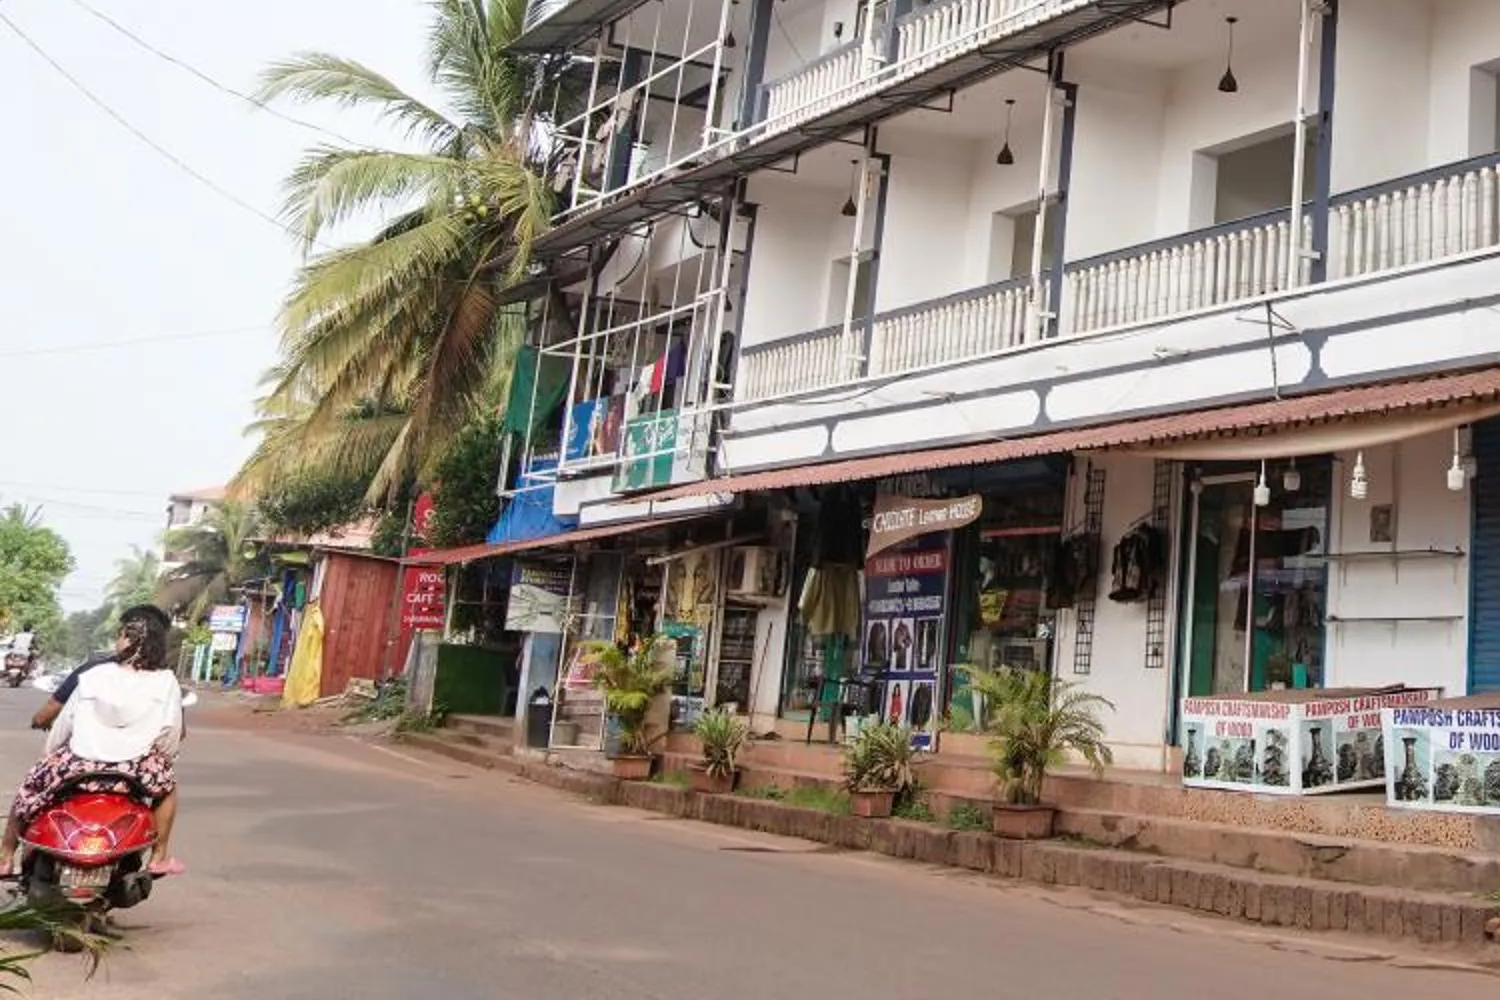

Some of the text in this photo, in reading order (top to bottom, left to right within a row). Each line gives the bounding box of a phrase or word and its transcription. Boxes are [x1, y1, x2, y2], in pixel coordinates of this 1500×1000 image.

[1304, 701, 1351, 718] PAMPOSH
[1393, 709, 1453, 727] PAMPOSH
[1347, 715, 1359, 729] OF
[1449, 731, 1465, 750] OF
